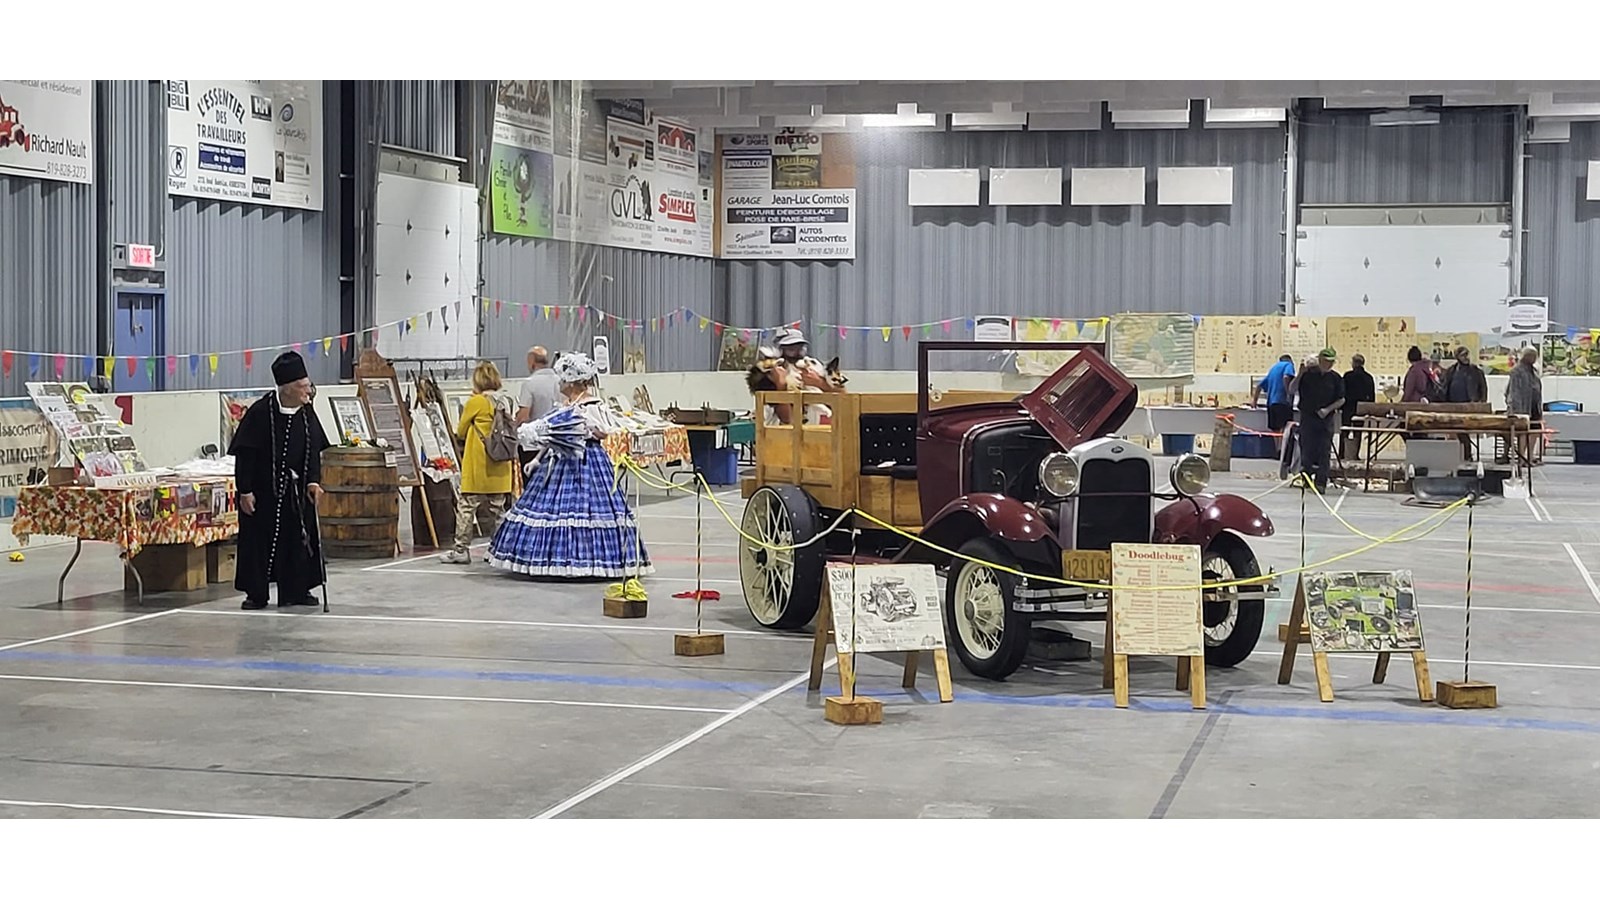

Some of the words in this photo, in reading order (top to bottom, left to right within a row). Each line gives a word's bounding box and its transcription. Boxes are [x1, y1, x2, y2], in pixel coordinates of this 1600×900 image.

[171, 94, 186, 107] BILL
[197, 88, 246, 125] L'ESSENTIEL
[216, 110, 228, 125] DES
[197, 123, 247, 145] TRAVAILLEURS
[31, 134, 64, 155] Richard
[66, 139, 87, 159] Nault
[175, 151, 183, 170] R
[611, 188, 642, 220] GVL
[658, 193, 696, 219] SIMPLEX
[727, 196, 762, 205] GARAGE
[771, 193, 811, 205] Jean-Luc
[812, 193, 850, 205] Comtois
[735, 208, 776, 216] PEINTURE
[781, 215, 826, 223] PARE-BRISE
[799, 227, 823, 235] AUTOS
[799, 235, 847, 243] ACCIDENTÉES
[1128, 550, 1186, 563] Doodlebug
